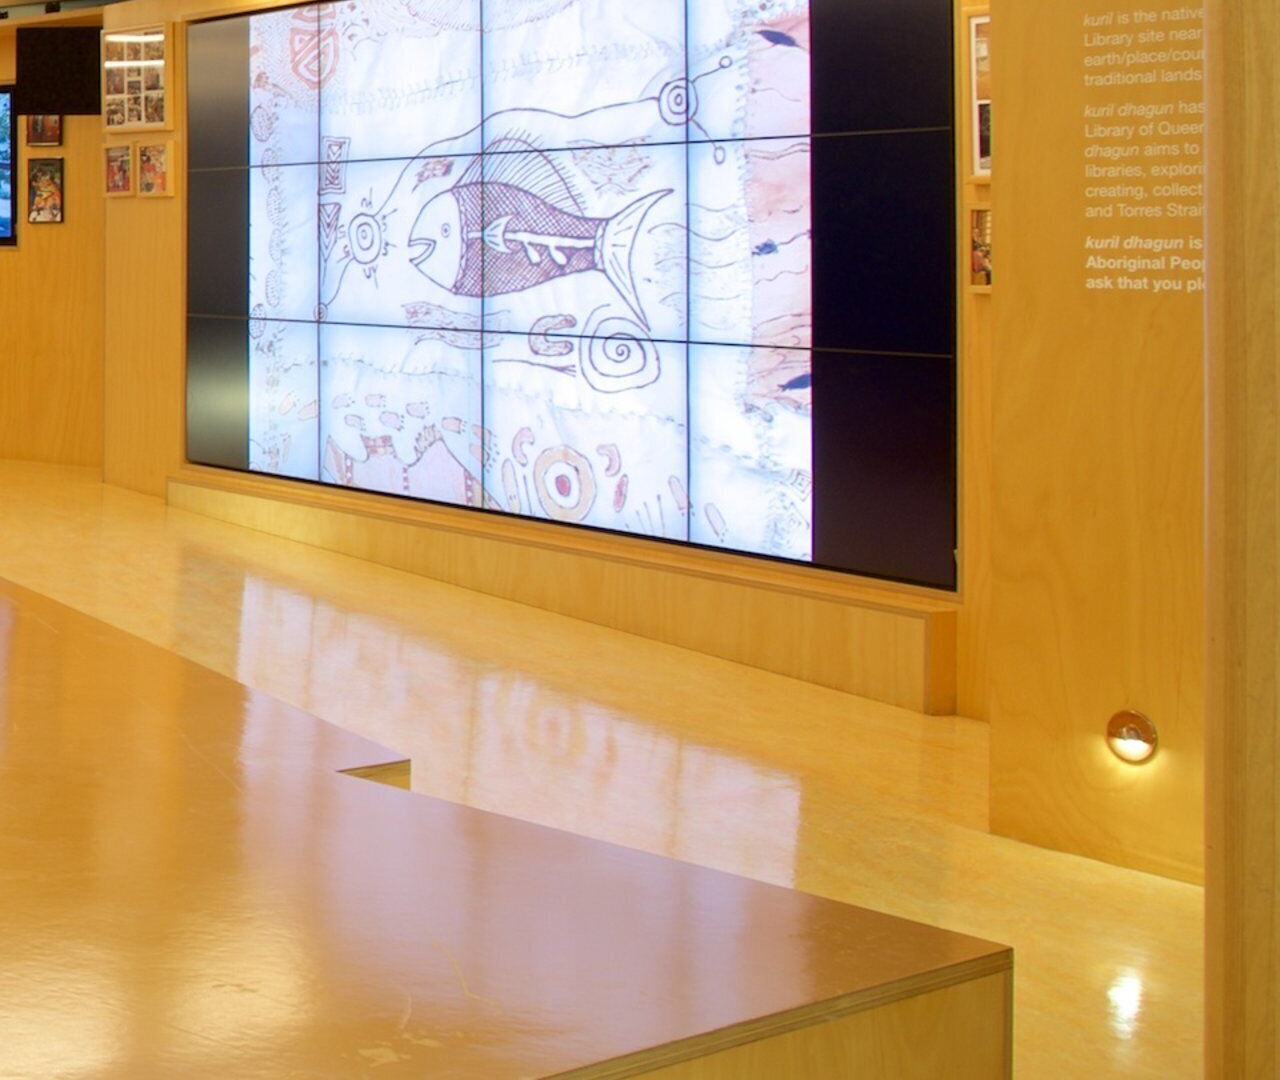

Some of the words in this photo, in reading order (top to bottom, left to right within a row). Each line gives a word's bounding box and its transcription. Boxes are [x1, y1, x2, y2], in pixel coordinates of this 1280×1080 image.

[1118, 11, 1129, 24] is
[1133, 9, 1157, 23] the
[1162, 7, 1205, 21] native
[1084, 32, 1133, 47] Library
[1138, 29, 1165, 43] site
[1170, 28, 1203, 40] near
[1084, 68, 1156, 86] traditional
[1162, 67, 1202, 82] lands
[1119, 102, 1174, 119] dhagun
[1179, 100, 1206, 114] has
[1085, 124, 1134, 140] Library
[1139, 122, 1154, 136] of
[1084, 143, 1139, 160] dhagun
[1144, 141, 1180, 156] aims
[1184, 142, 1200, 155] to
[1085, 183, 1148, 200] creating,
[1086, 203, 1113, 218] and
[1117, 203, 1162, 218] Torres
[1086, 235, 1120, 249] kuril
[1123, 235, 1184, 252] dhagun
[1189, 235, 1202, 249] is
[1086, 254, 1166, 272] Aboriginal
[1086, 275, 1113, 290] ask
[1117, 275, 1149, 290] that
[1153, 278, 1182, 293] you
